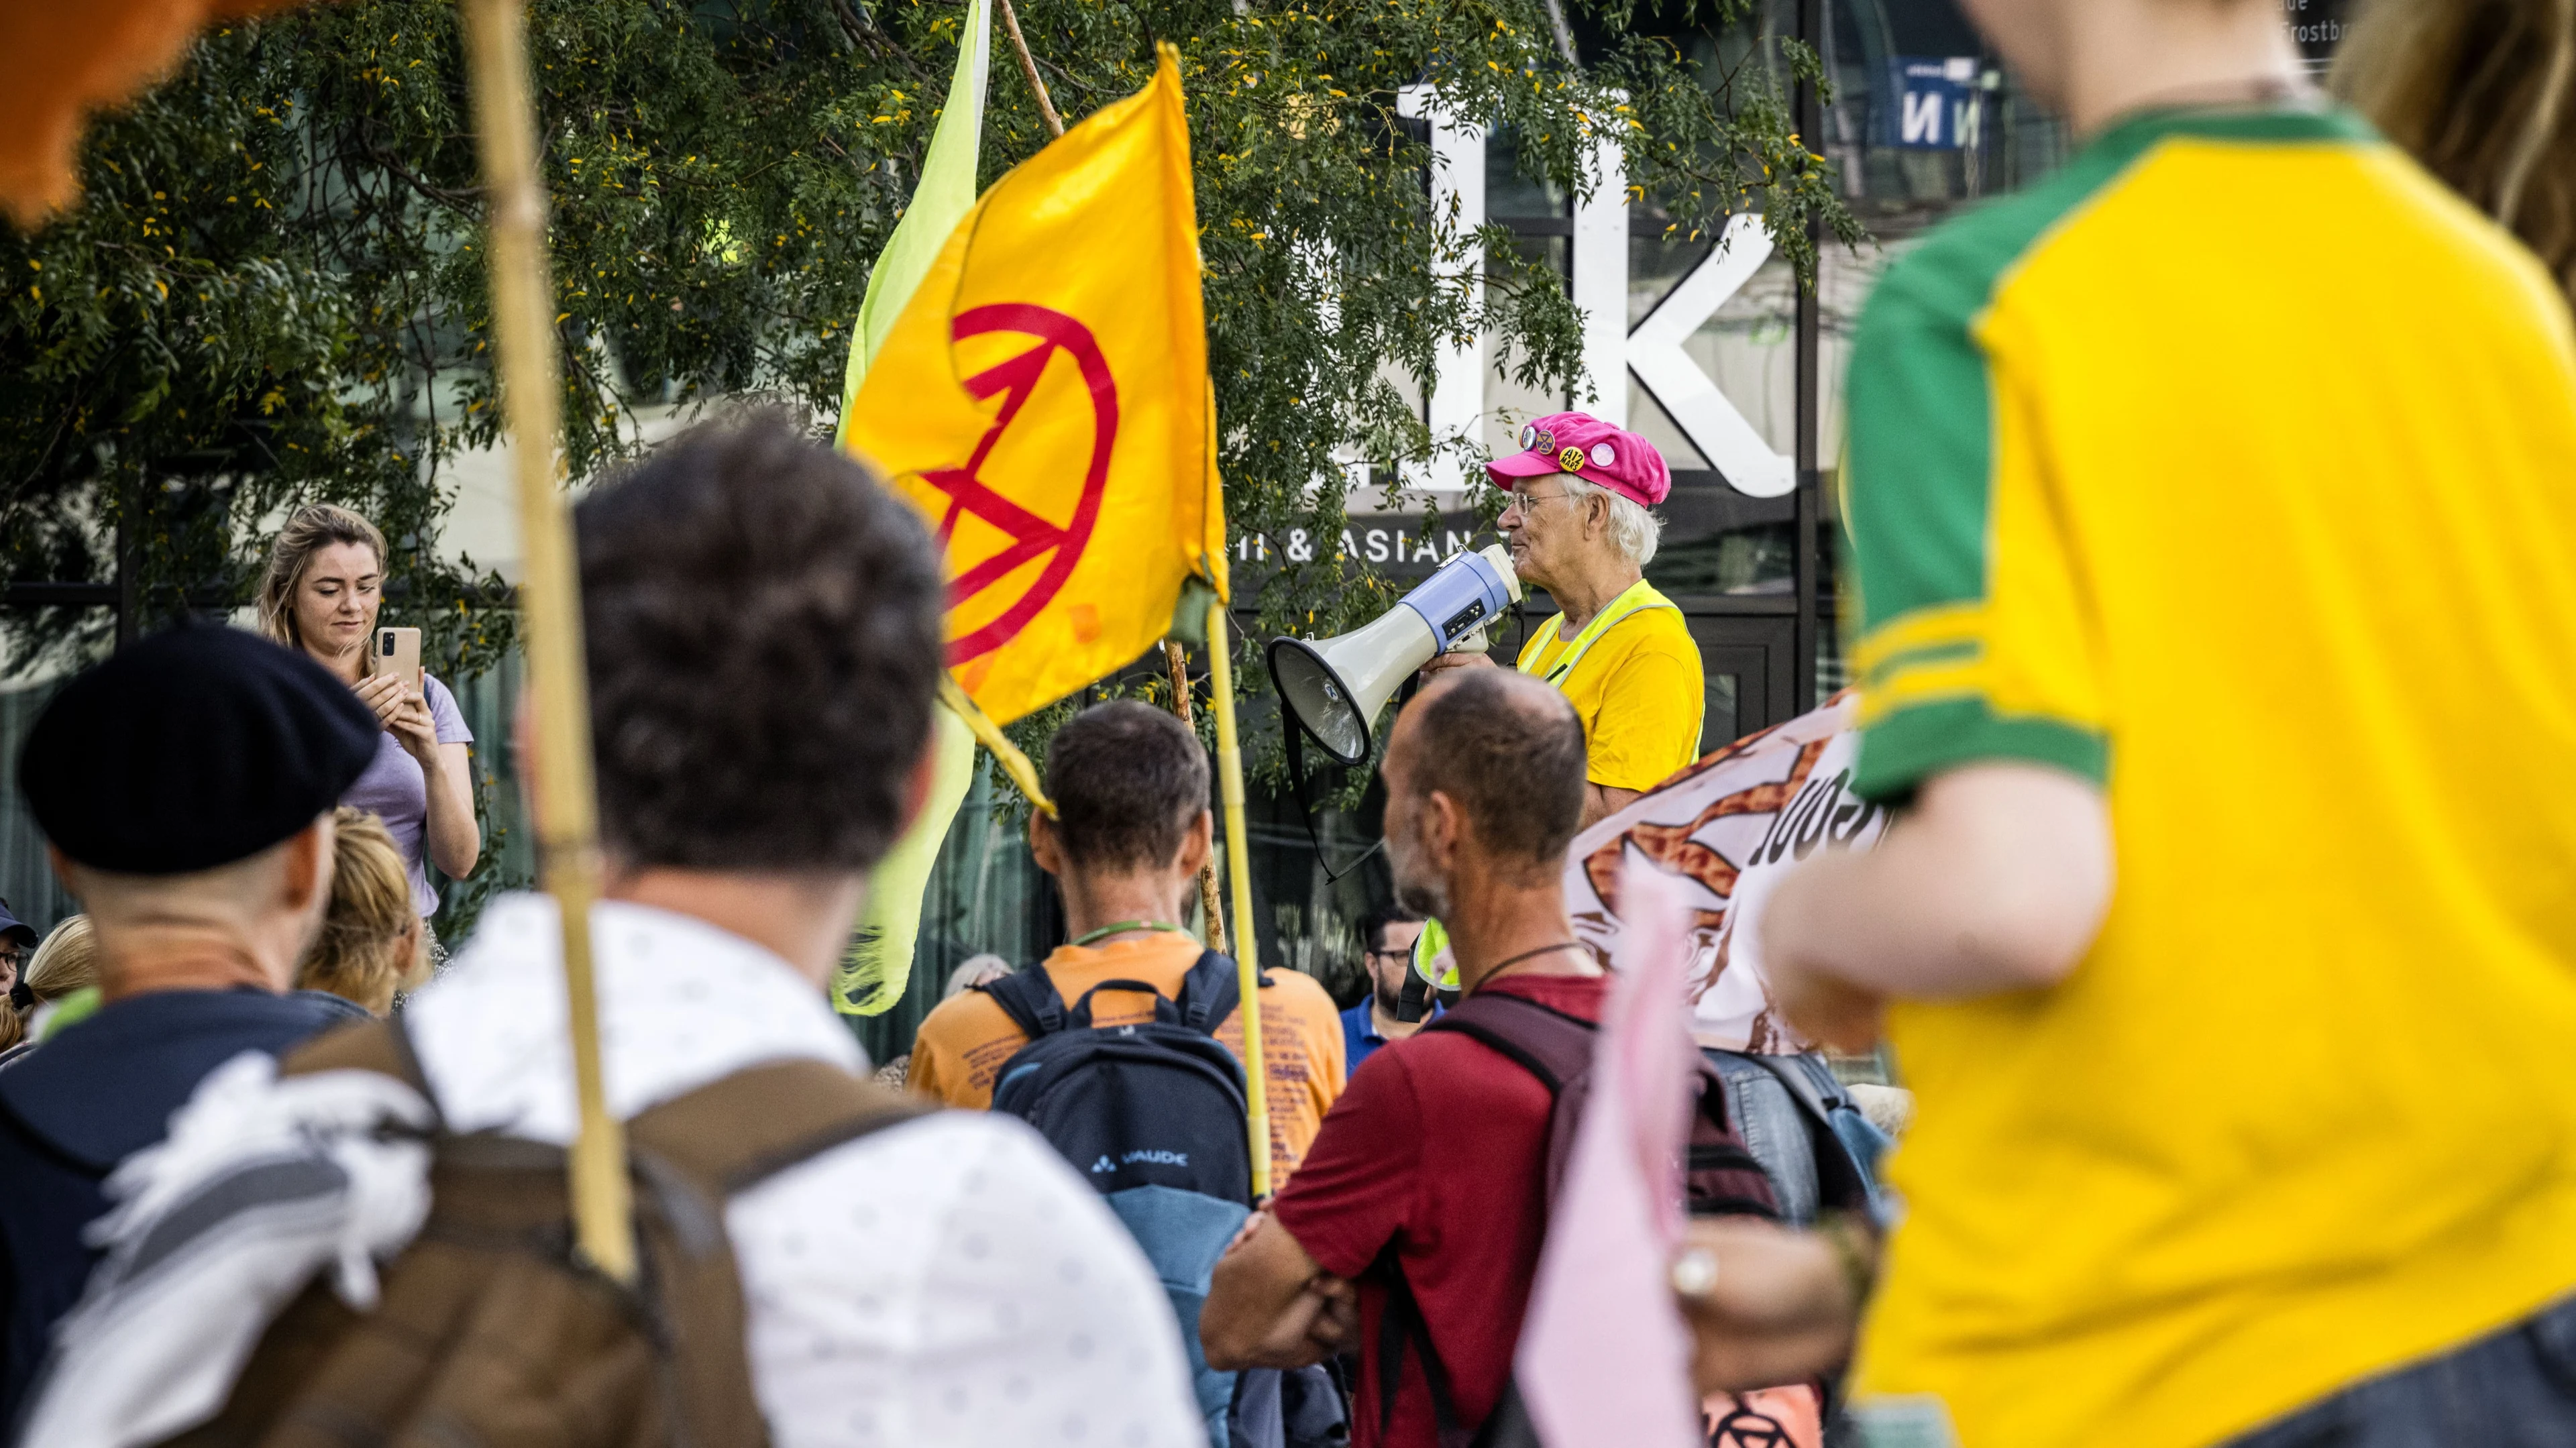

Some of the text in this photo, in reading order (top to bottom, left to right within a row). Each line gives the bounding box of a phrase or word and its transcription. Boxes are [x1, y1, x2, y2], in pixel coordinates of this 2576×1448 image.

[1560, 456, 1578, 471] MARS
[1564, 448, 1584, 465] A12
[1287, 528, 1312, 561] &
[1337, 529, 1472, 563] ASIAN
[1121, 1149, 1189, 1167] VAUDE
